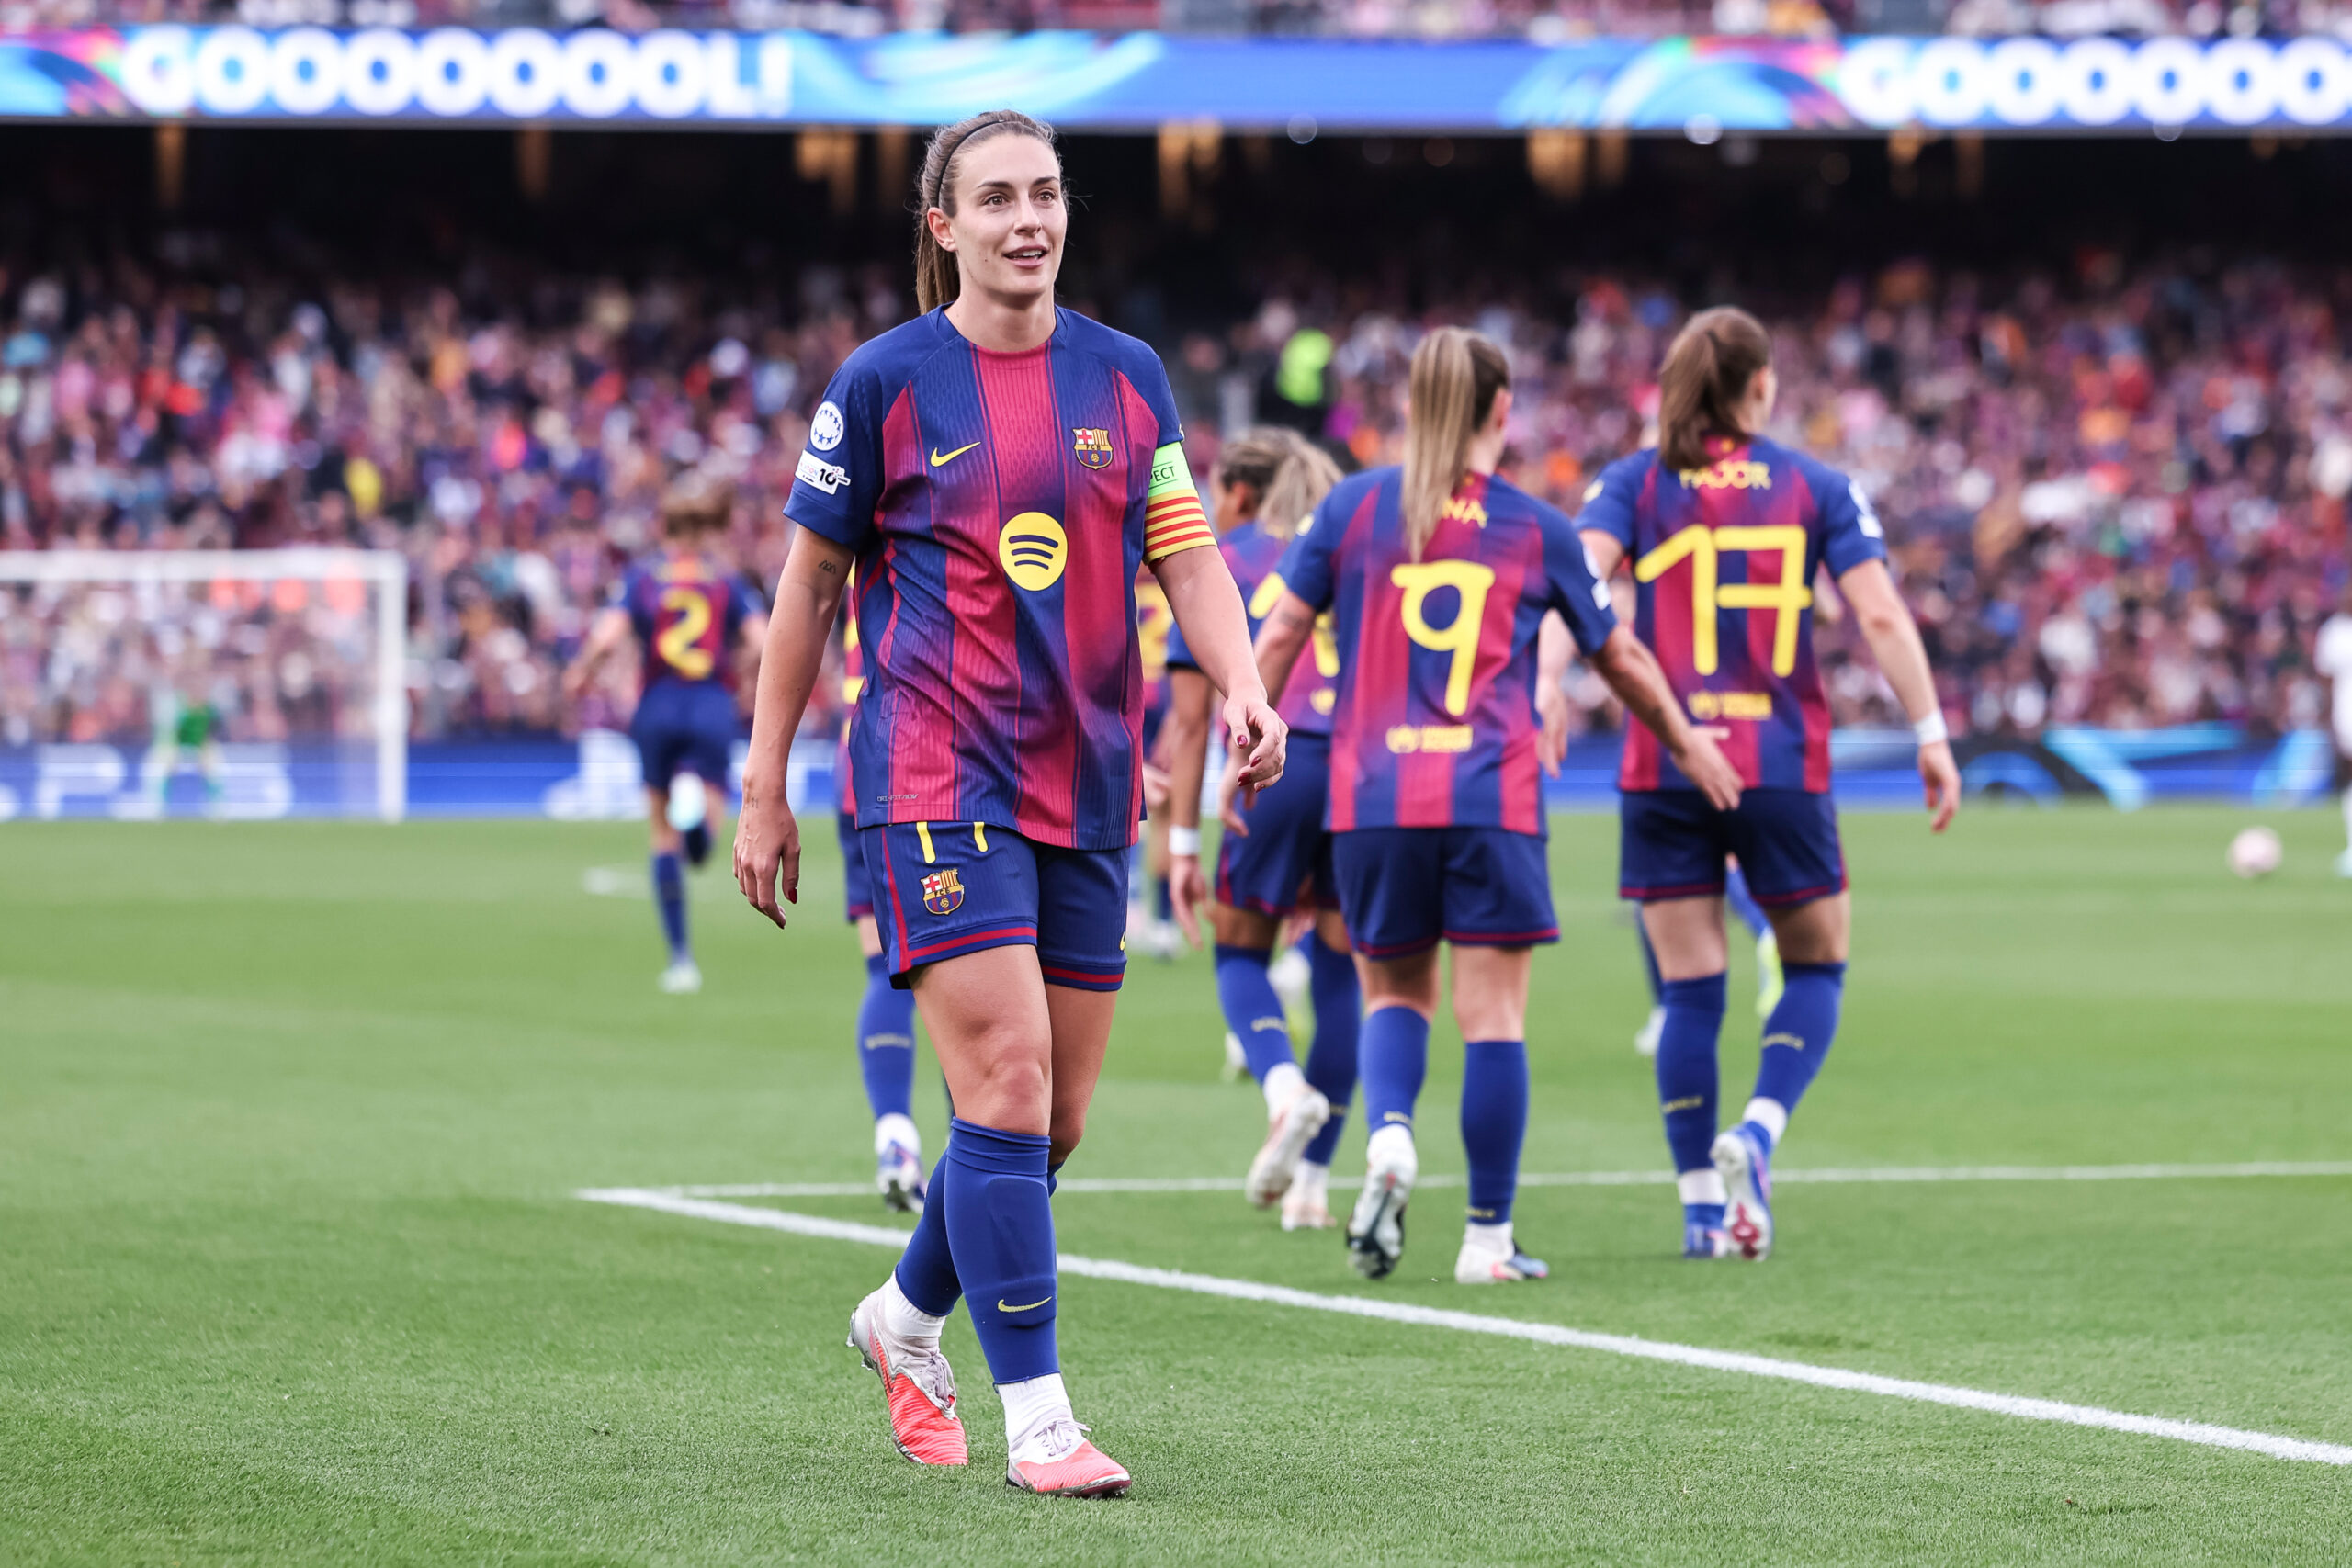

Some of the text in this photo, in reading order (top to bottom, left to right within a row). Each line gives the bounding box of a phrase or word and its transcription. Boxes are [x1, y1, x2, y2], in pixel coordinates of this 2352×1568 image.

[1151, 466, 1176, 482] ECT
[657, 585, 714, 680] 2
[1390, 558, 1496, 716] 9
[1634, 524, 1813, 677] 17
